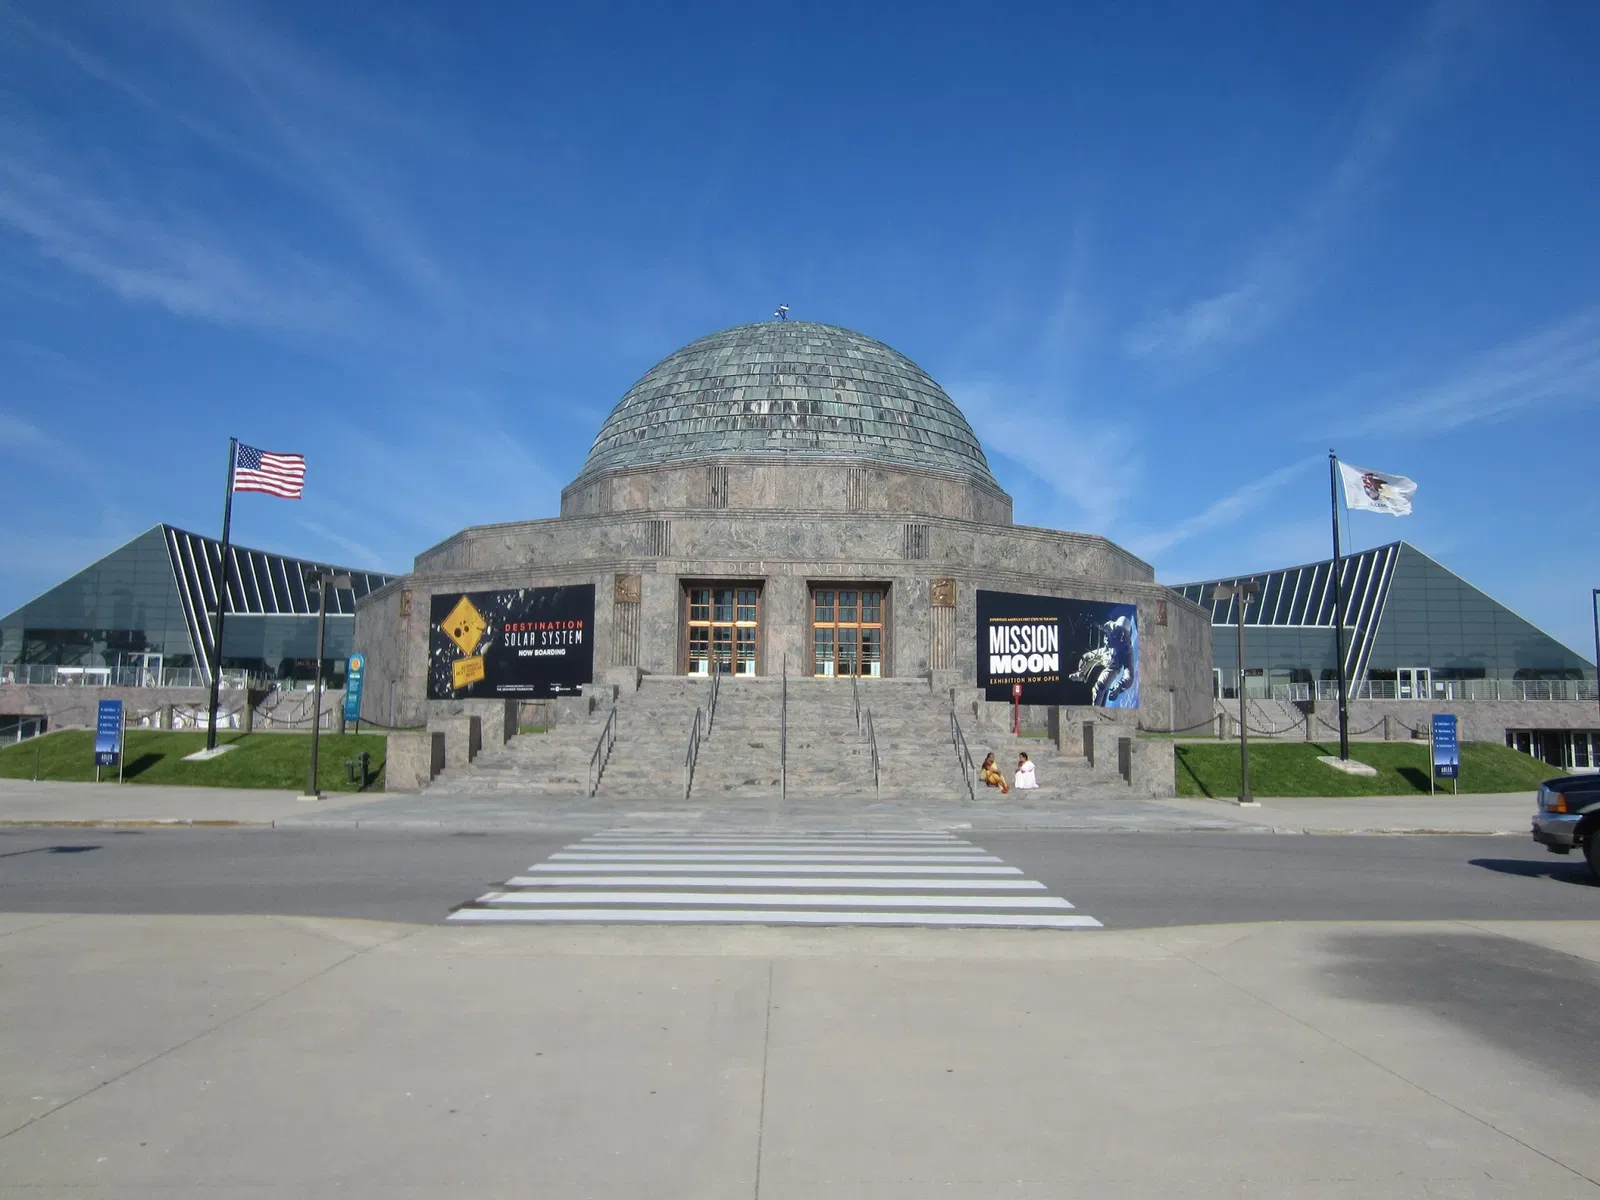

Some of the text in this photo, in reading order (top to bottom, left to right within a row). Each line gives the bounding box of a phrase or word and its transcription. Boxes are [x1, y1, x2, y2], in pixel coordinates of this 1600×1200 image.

[505, 620, 583, 632] DESTINATION
[504, 630, 582, 647] SOLAR SYSTEM
[989, 624, 1058, 654] MISSION
[518, 648, 566, 657] NOW BOARDING
[990, 653, 1059, 674] MOON
